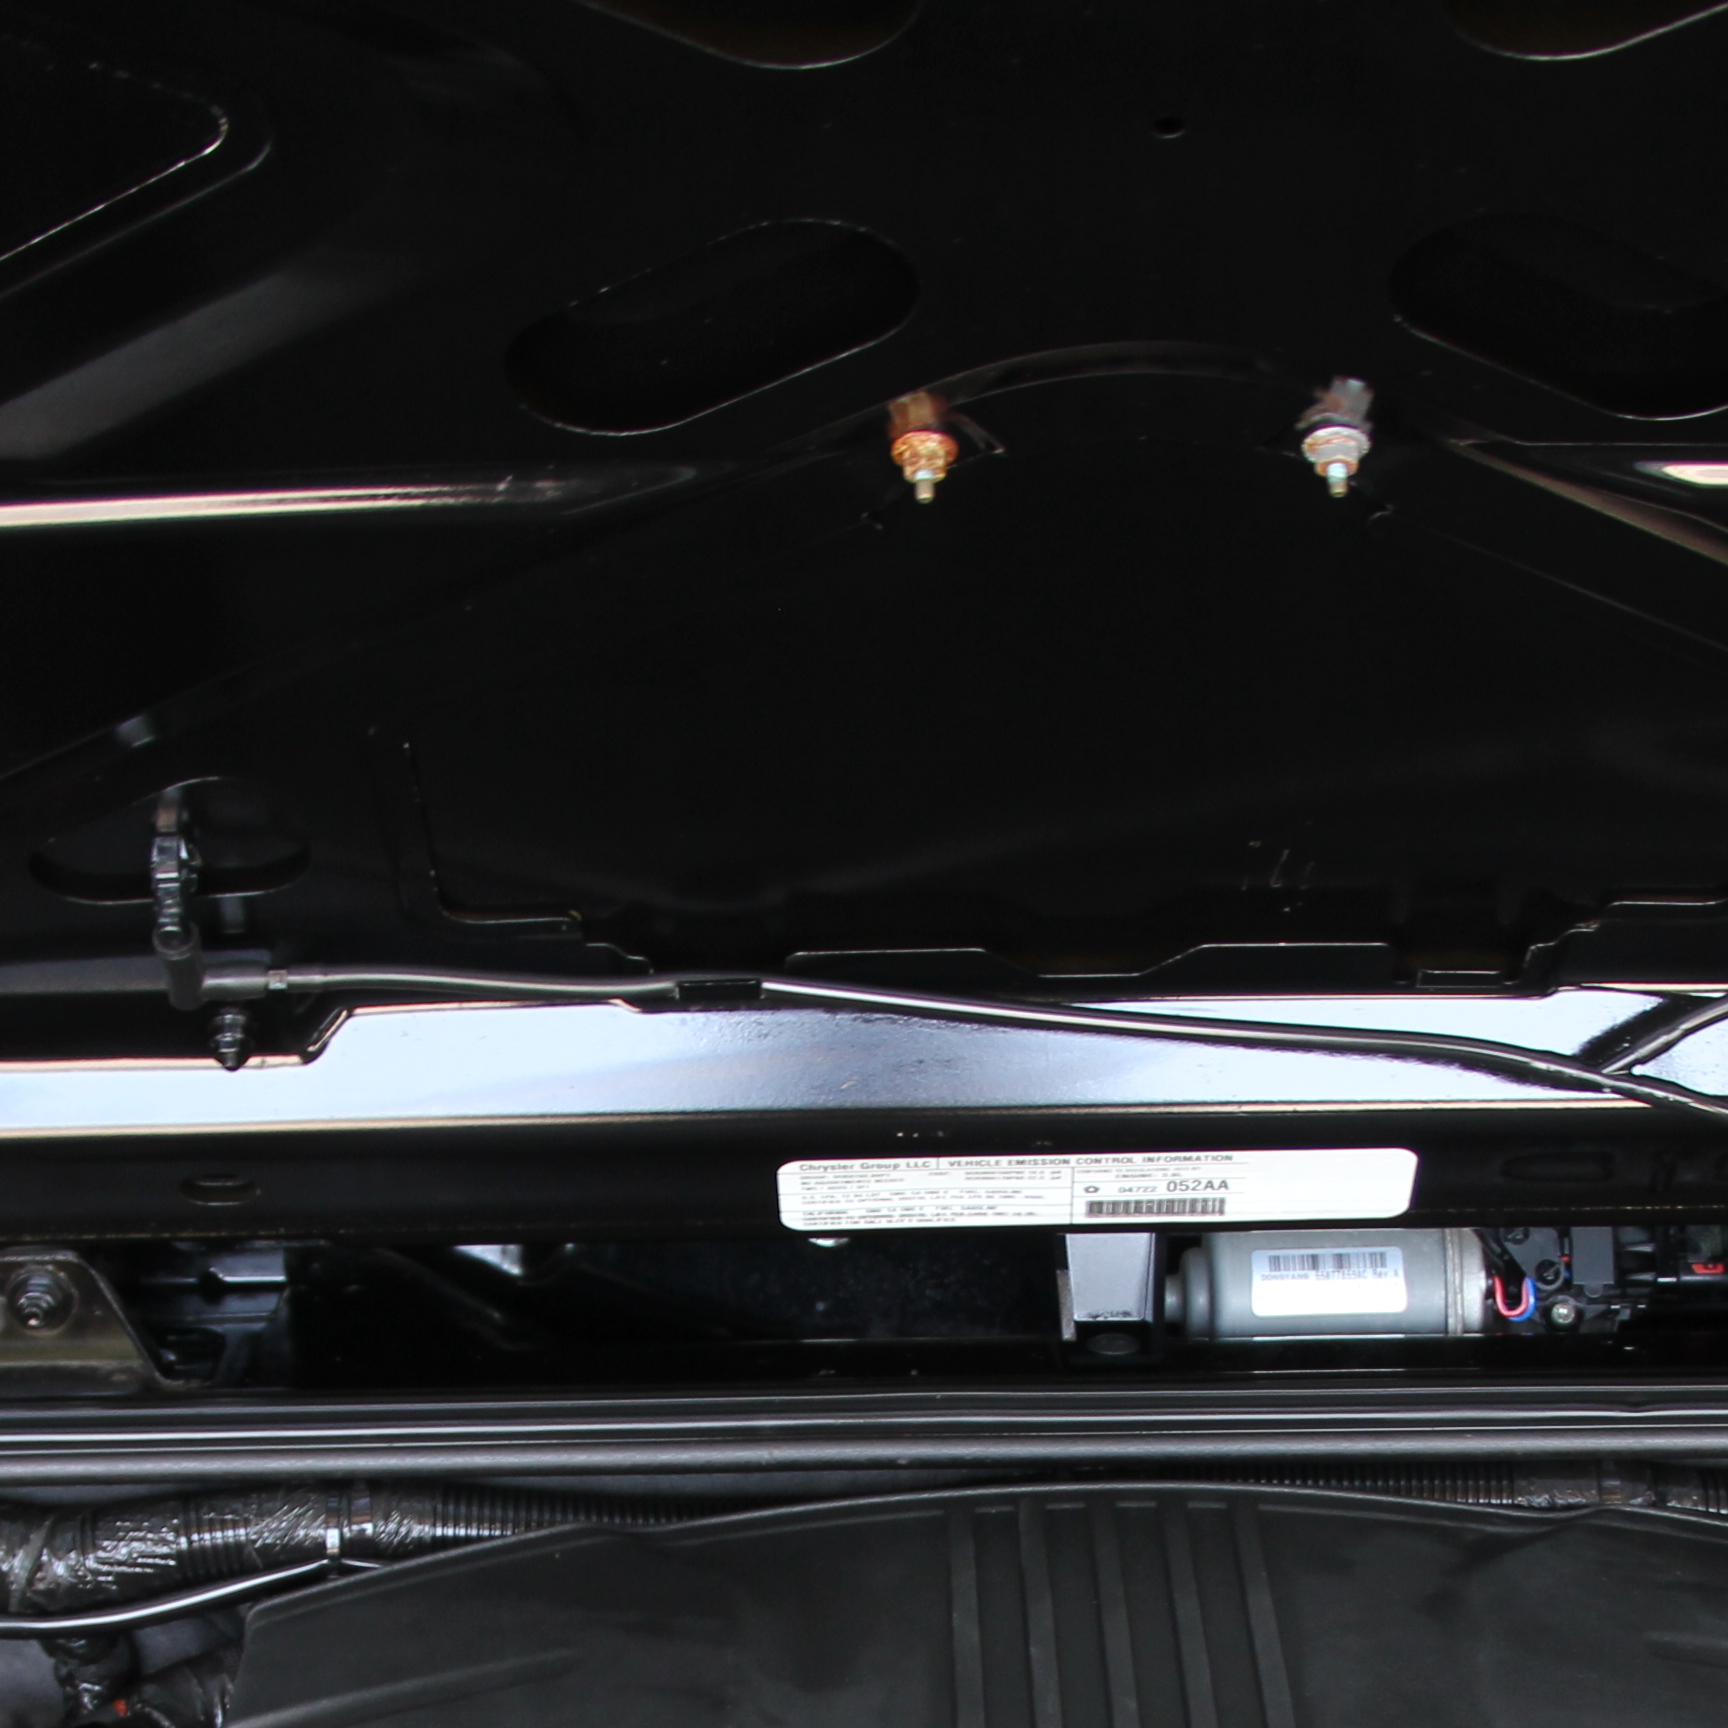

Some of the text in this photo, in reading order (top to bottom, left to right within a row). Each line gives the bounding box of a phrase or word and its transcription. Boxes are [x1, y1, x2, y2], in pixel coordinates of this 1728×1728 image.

[798, 1160, 932, 1173] Chrysler Group LLC
[948, 1154, 1234, 1168] VEHICLE EMISSION CONTROL INFORMATION
[1165, 1179, 1230, 1193] 052AA
